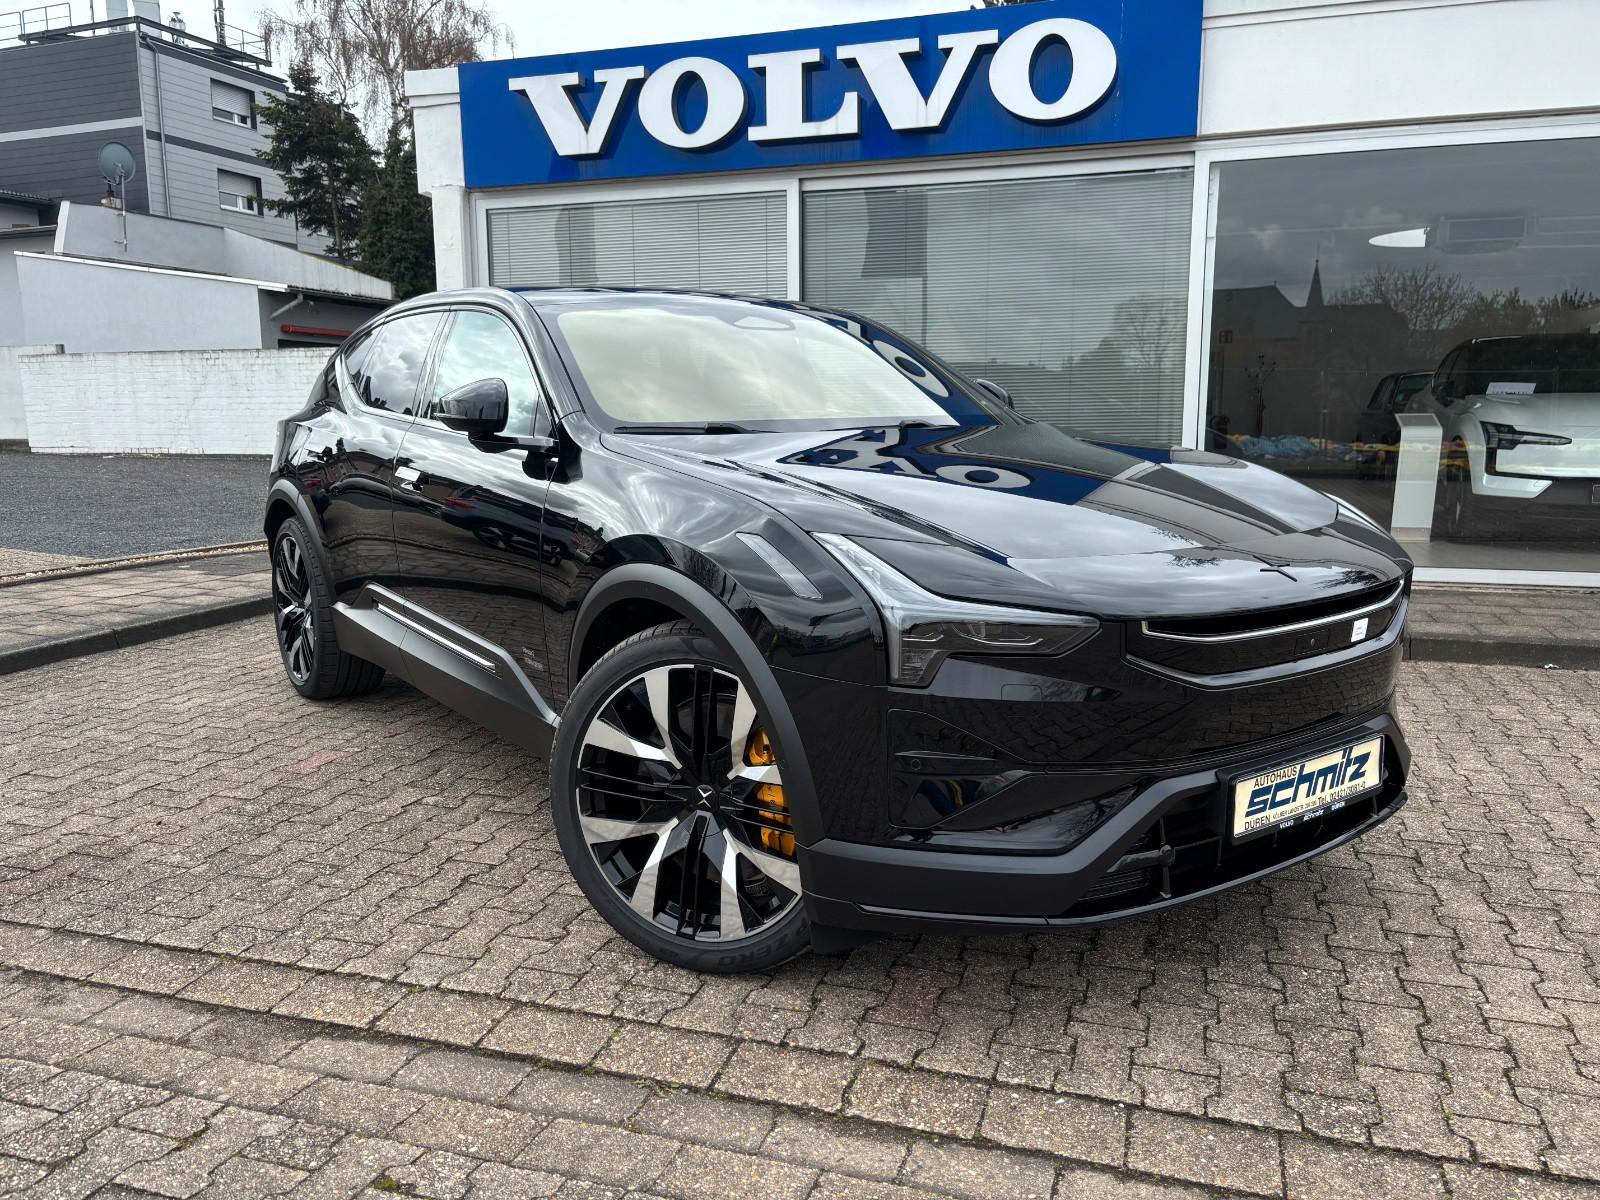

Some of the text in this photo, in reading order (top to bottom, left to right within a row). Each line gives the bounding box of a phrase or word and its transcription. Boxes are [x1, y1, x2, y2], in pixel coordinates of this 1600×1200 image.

[508, 17, 1118, 157] VOLVO
[1253, 766, 1298, 788] AUTOHAUS
[1244, 814, 1271, 831] DÜREN
[1317, 795, 1328, 806] Tel.
